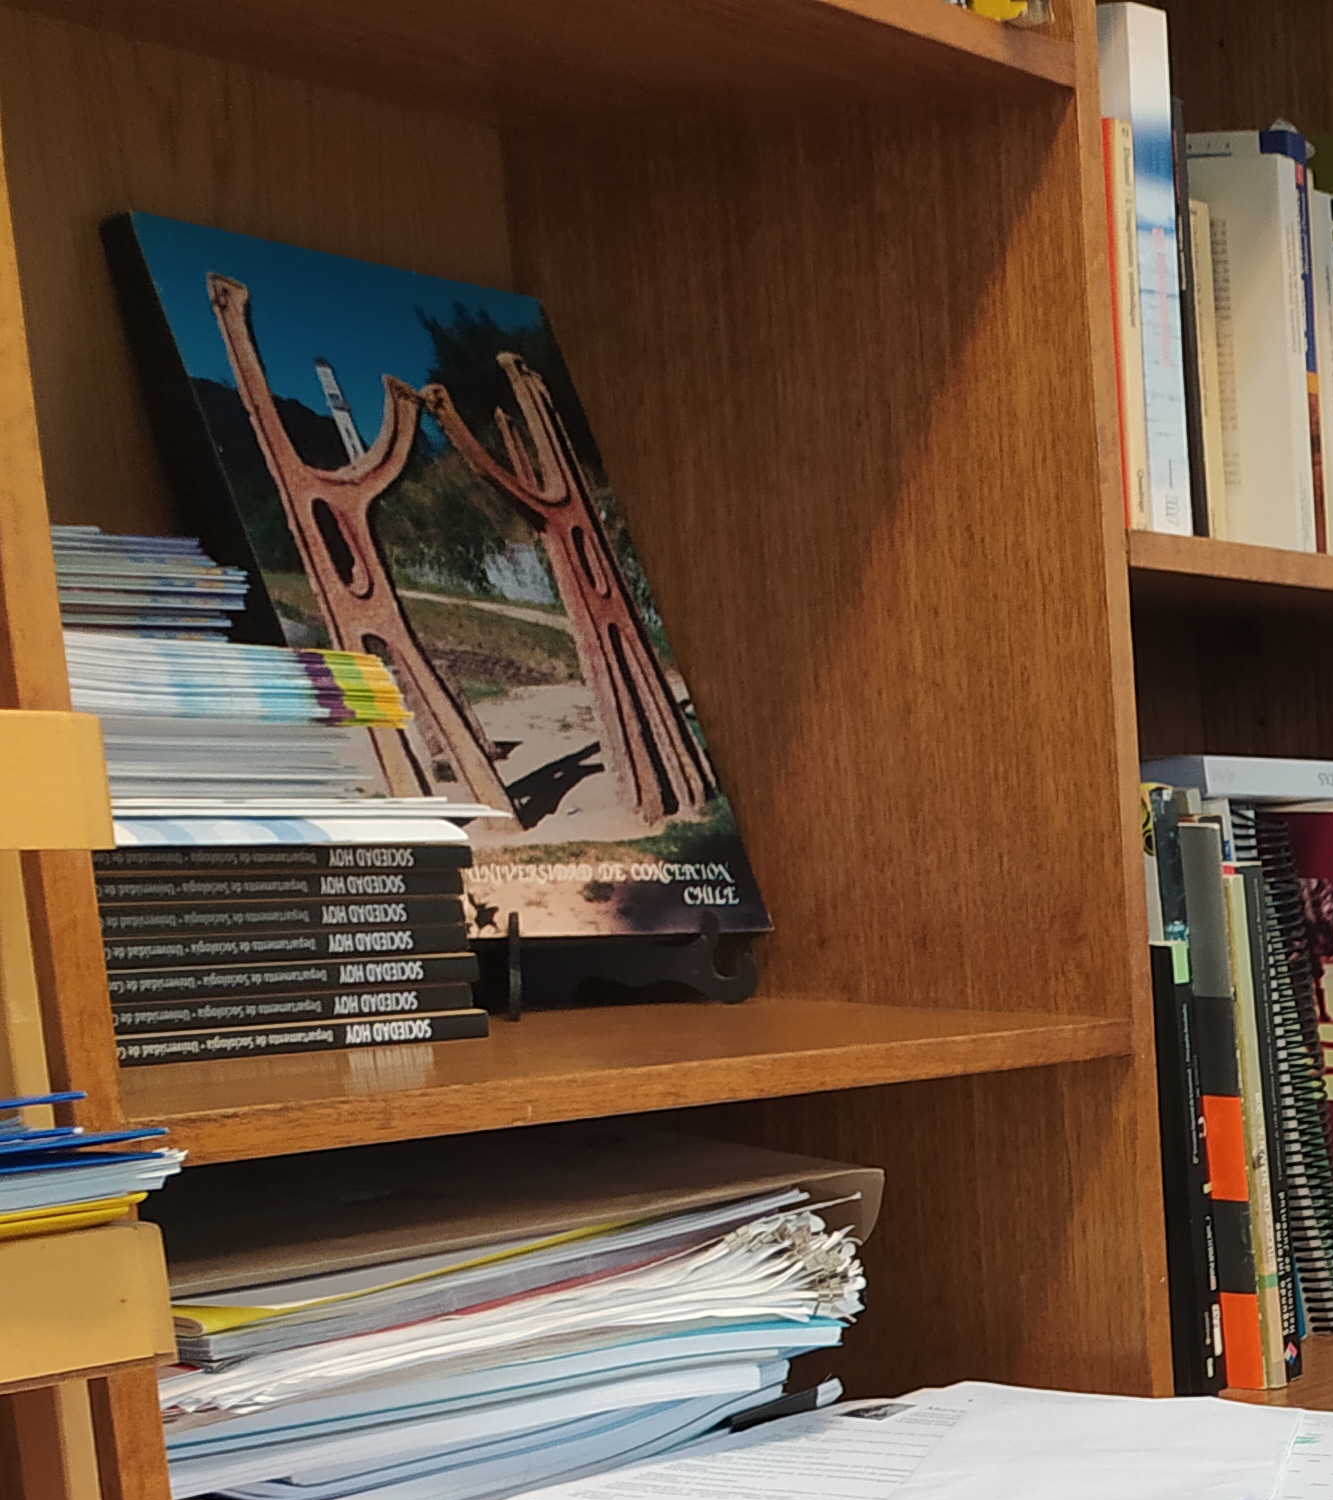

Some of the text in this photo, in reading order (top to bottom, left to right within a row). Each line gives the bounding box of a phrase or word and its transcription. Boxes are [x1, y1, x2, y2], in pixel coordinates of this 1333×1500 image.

[328, 848, 414, 867] SOCIEDAD HOY
[464, 862, 594, 883] UNIVERSIDAD
[598, 863, 627, 882] DE
[320, 874, 406, 894] SOCIEDAD HOY
[683, 884, 741, 905] CHILE
[322, 903, 407, 924] SOCIEDAD HOY
[328, 931, 413, 953] SOCIEDAD HOY
[339, 961, 424, 984] SOCIEDAD HOY
[333, 991, 418, 1015] SOCIEDAD HOY
[128, 1019, 432, 1058] SOCIEDAD HOY Departamento de Sociología Universidad de
[1276, 1190, 1297, 1333] Nacional de Juventud
[1271, 1221, 1291, 1335] Segundo Informe
